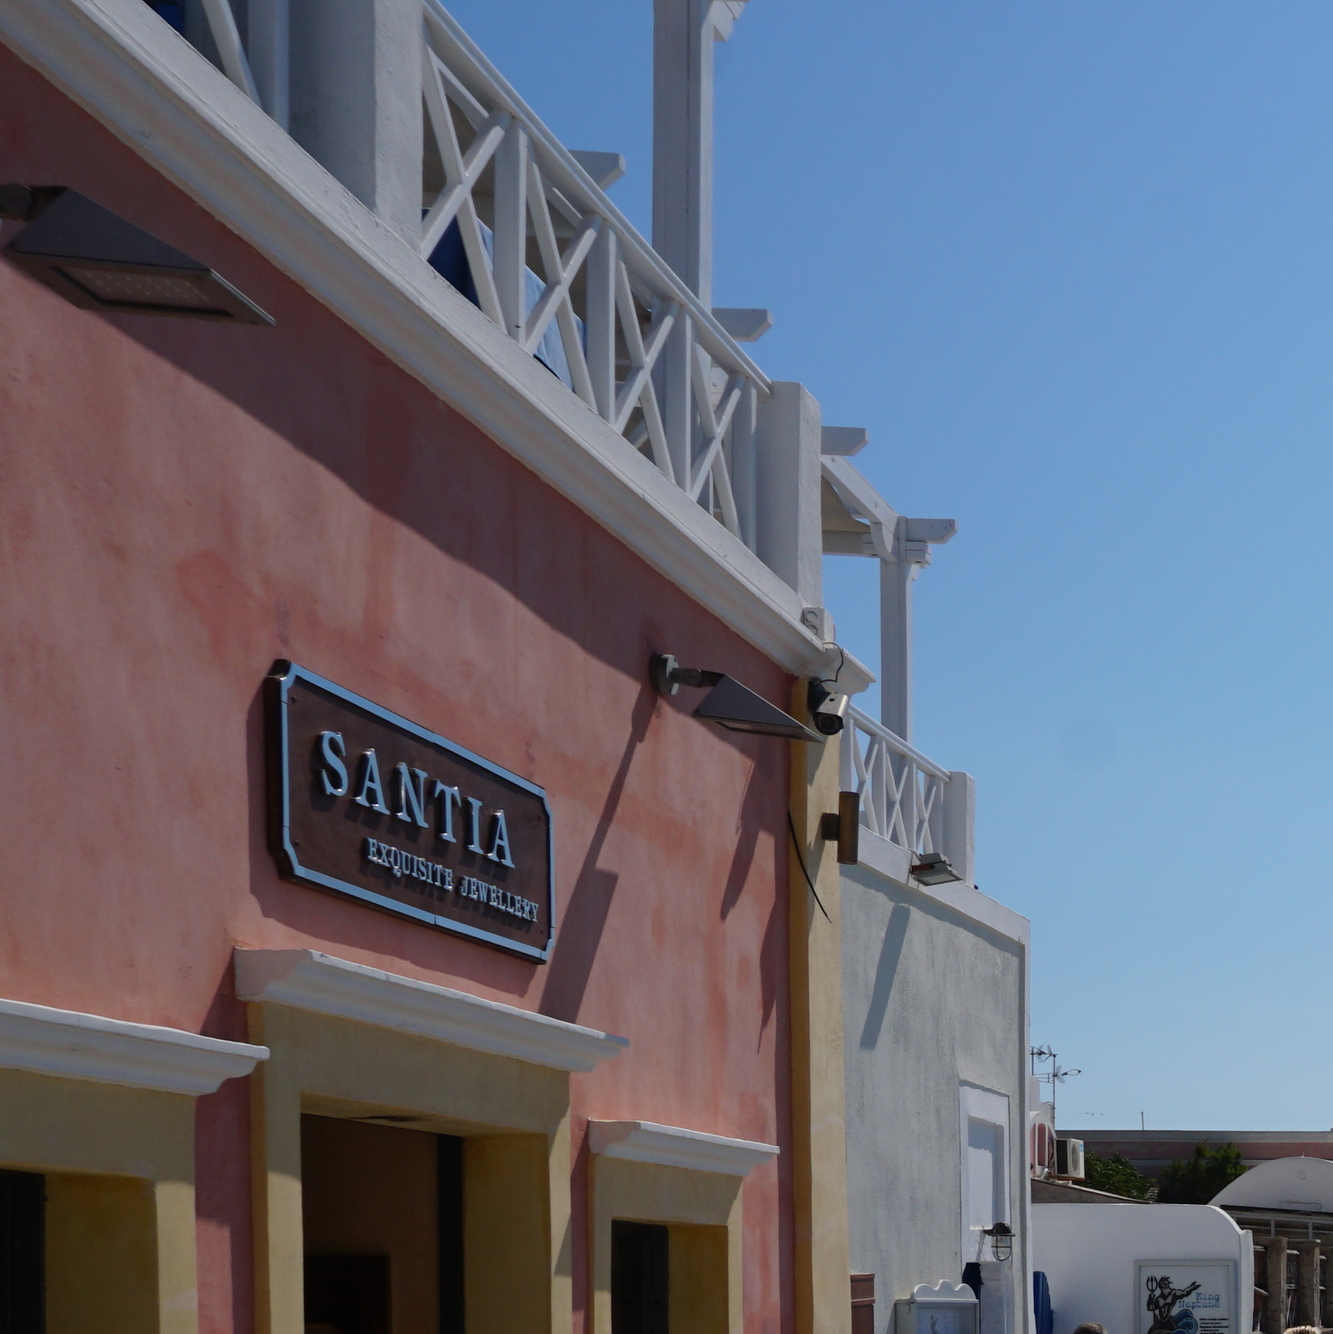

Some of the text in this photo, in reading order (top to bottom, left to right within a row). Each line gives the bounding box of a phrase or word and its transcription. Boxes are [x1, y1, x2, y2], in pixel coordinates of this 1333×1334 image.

[318, 729, 516, 869] SANTIA
[364, 836, 540, 923] EXQUISITE JEWELLERY
[1178, 1300, 1220, 1310] Neptune
[1195, 1292, 1220, 1302] King
